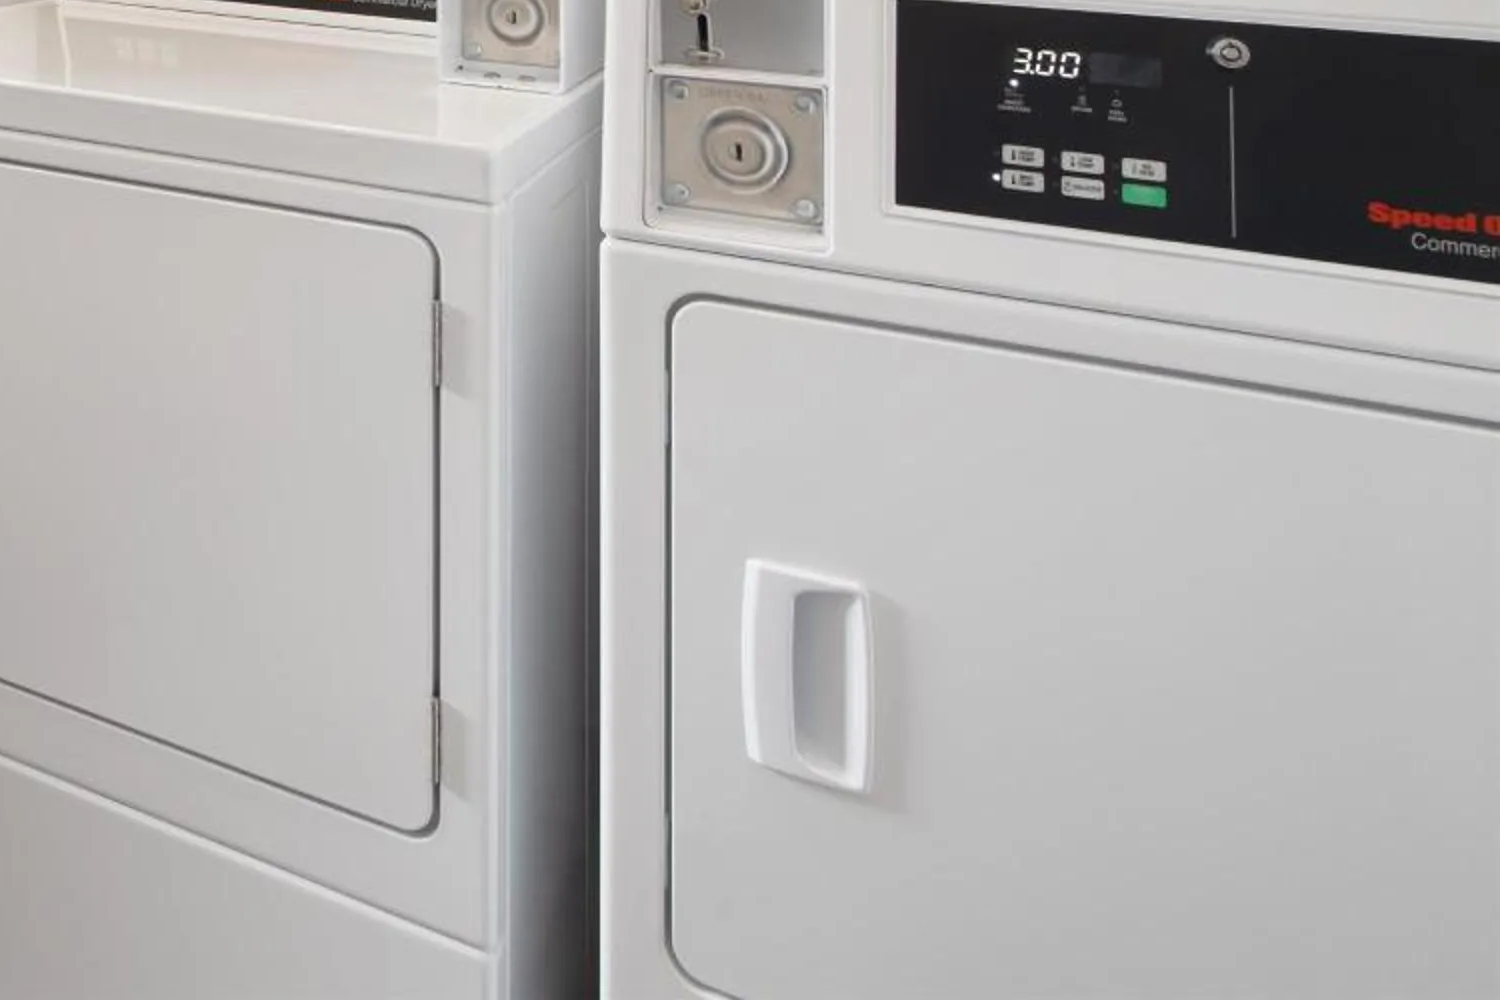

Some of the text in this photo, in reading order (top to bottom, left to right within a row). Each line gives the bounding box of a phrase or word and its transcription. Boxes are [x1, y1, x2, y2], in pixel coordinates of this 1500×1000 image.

[1012, 47, 1081, 79] 3.00
[1367, 200, 1477, 232] Speed
[1411, 231, 1500, 259] Commer
